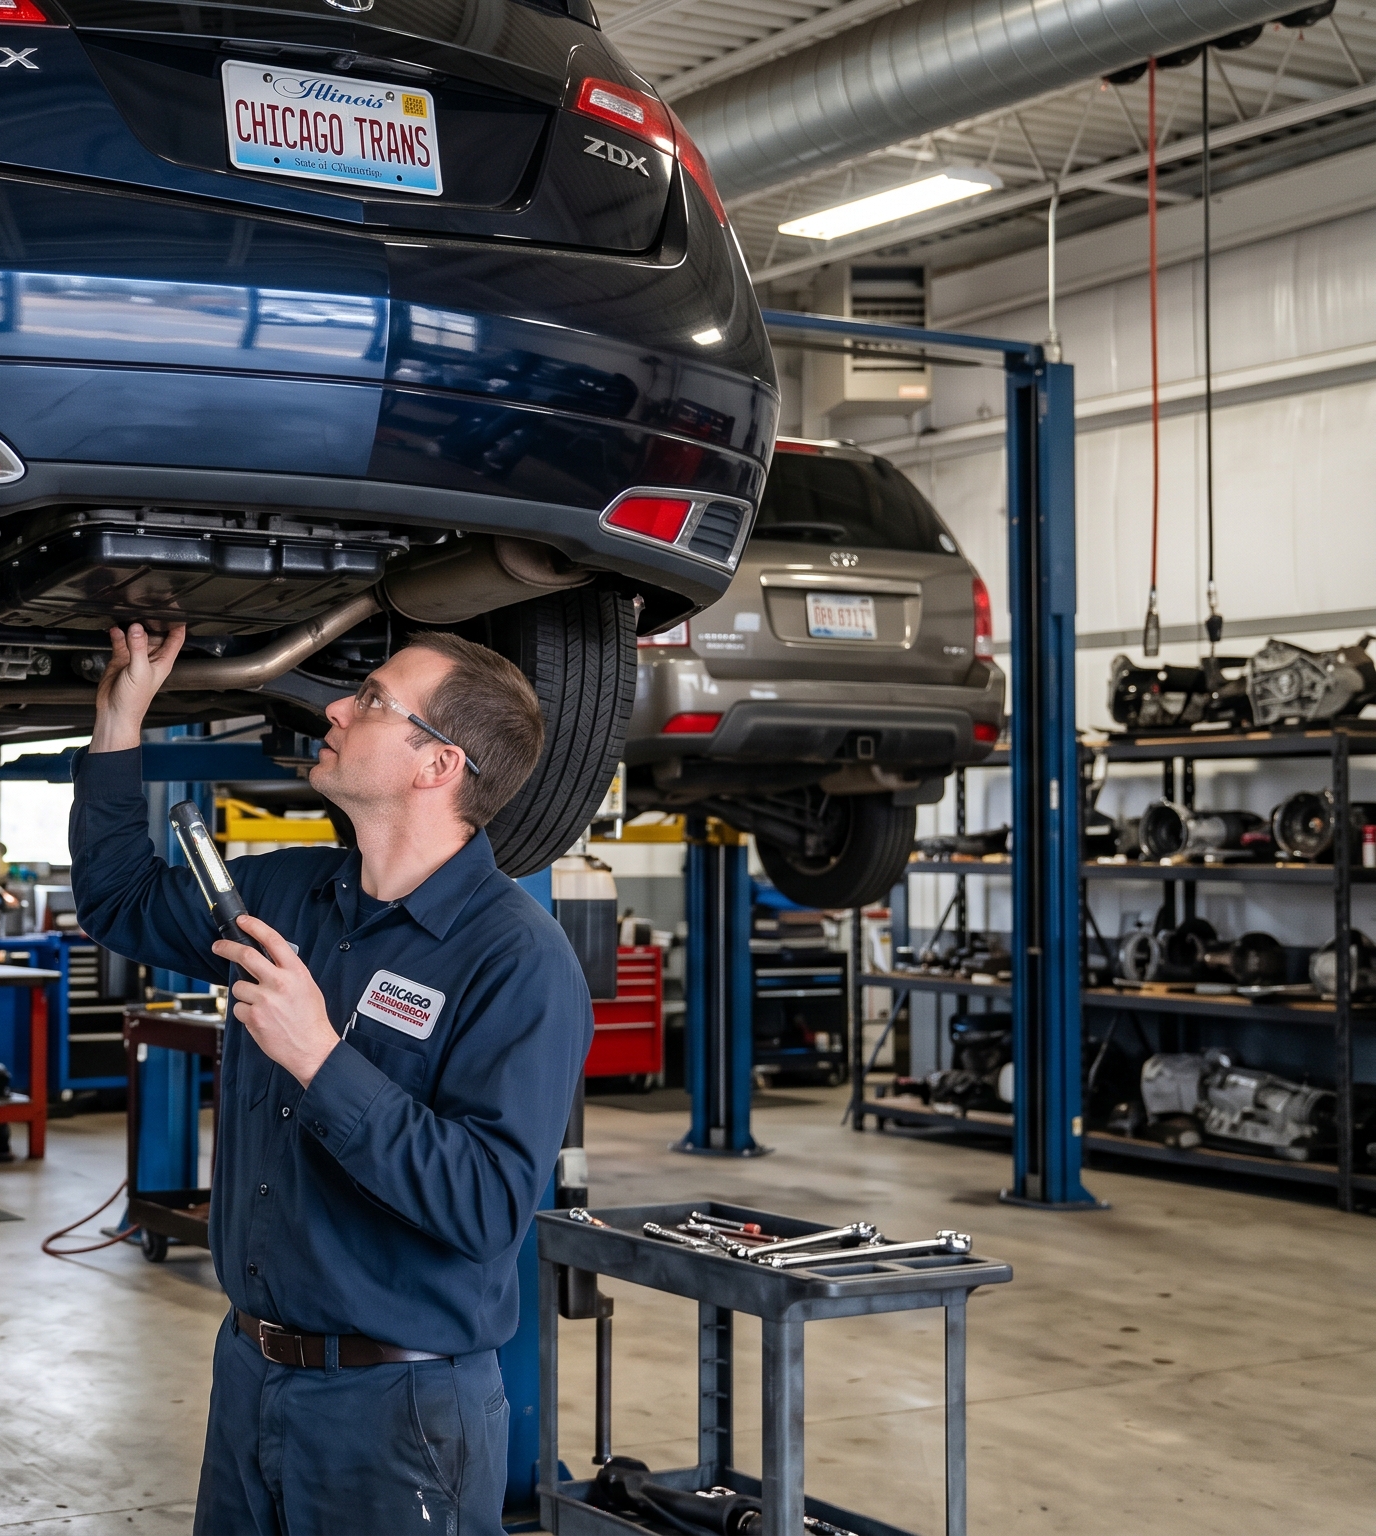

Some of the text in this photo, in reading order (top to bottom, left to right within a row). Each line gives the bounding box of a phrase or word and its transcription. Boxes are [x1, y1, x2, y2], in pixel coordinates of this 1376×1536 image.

[273, 77, 385, 109] Illinois
[235, 98, 432, 168] CHICAGO TRANS
[583, 134, 651, 179] ZDX
[379, 981, 432, 1010] CHICAGO
